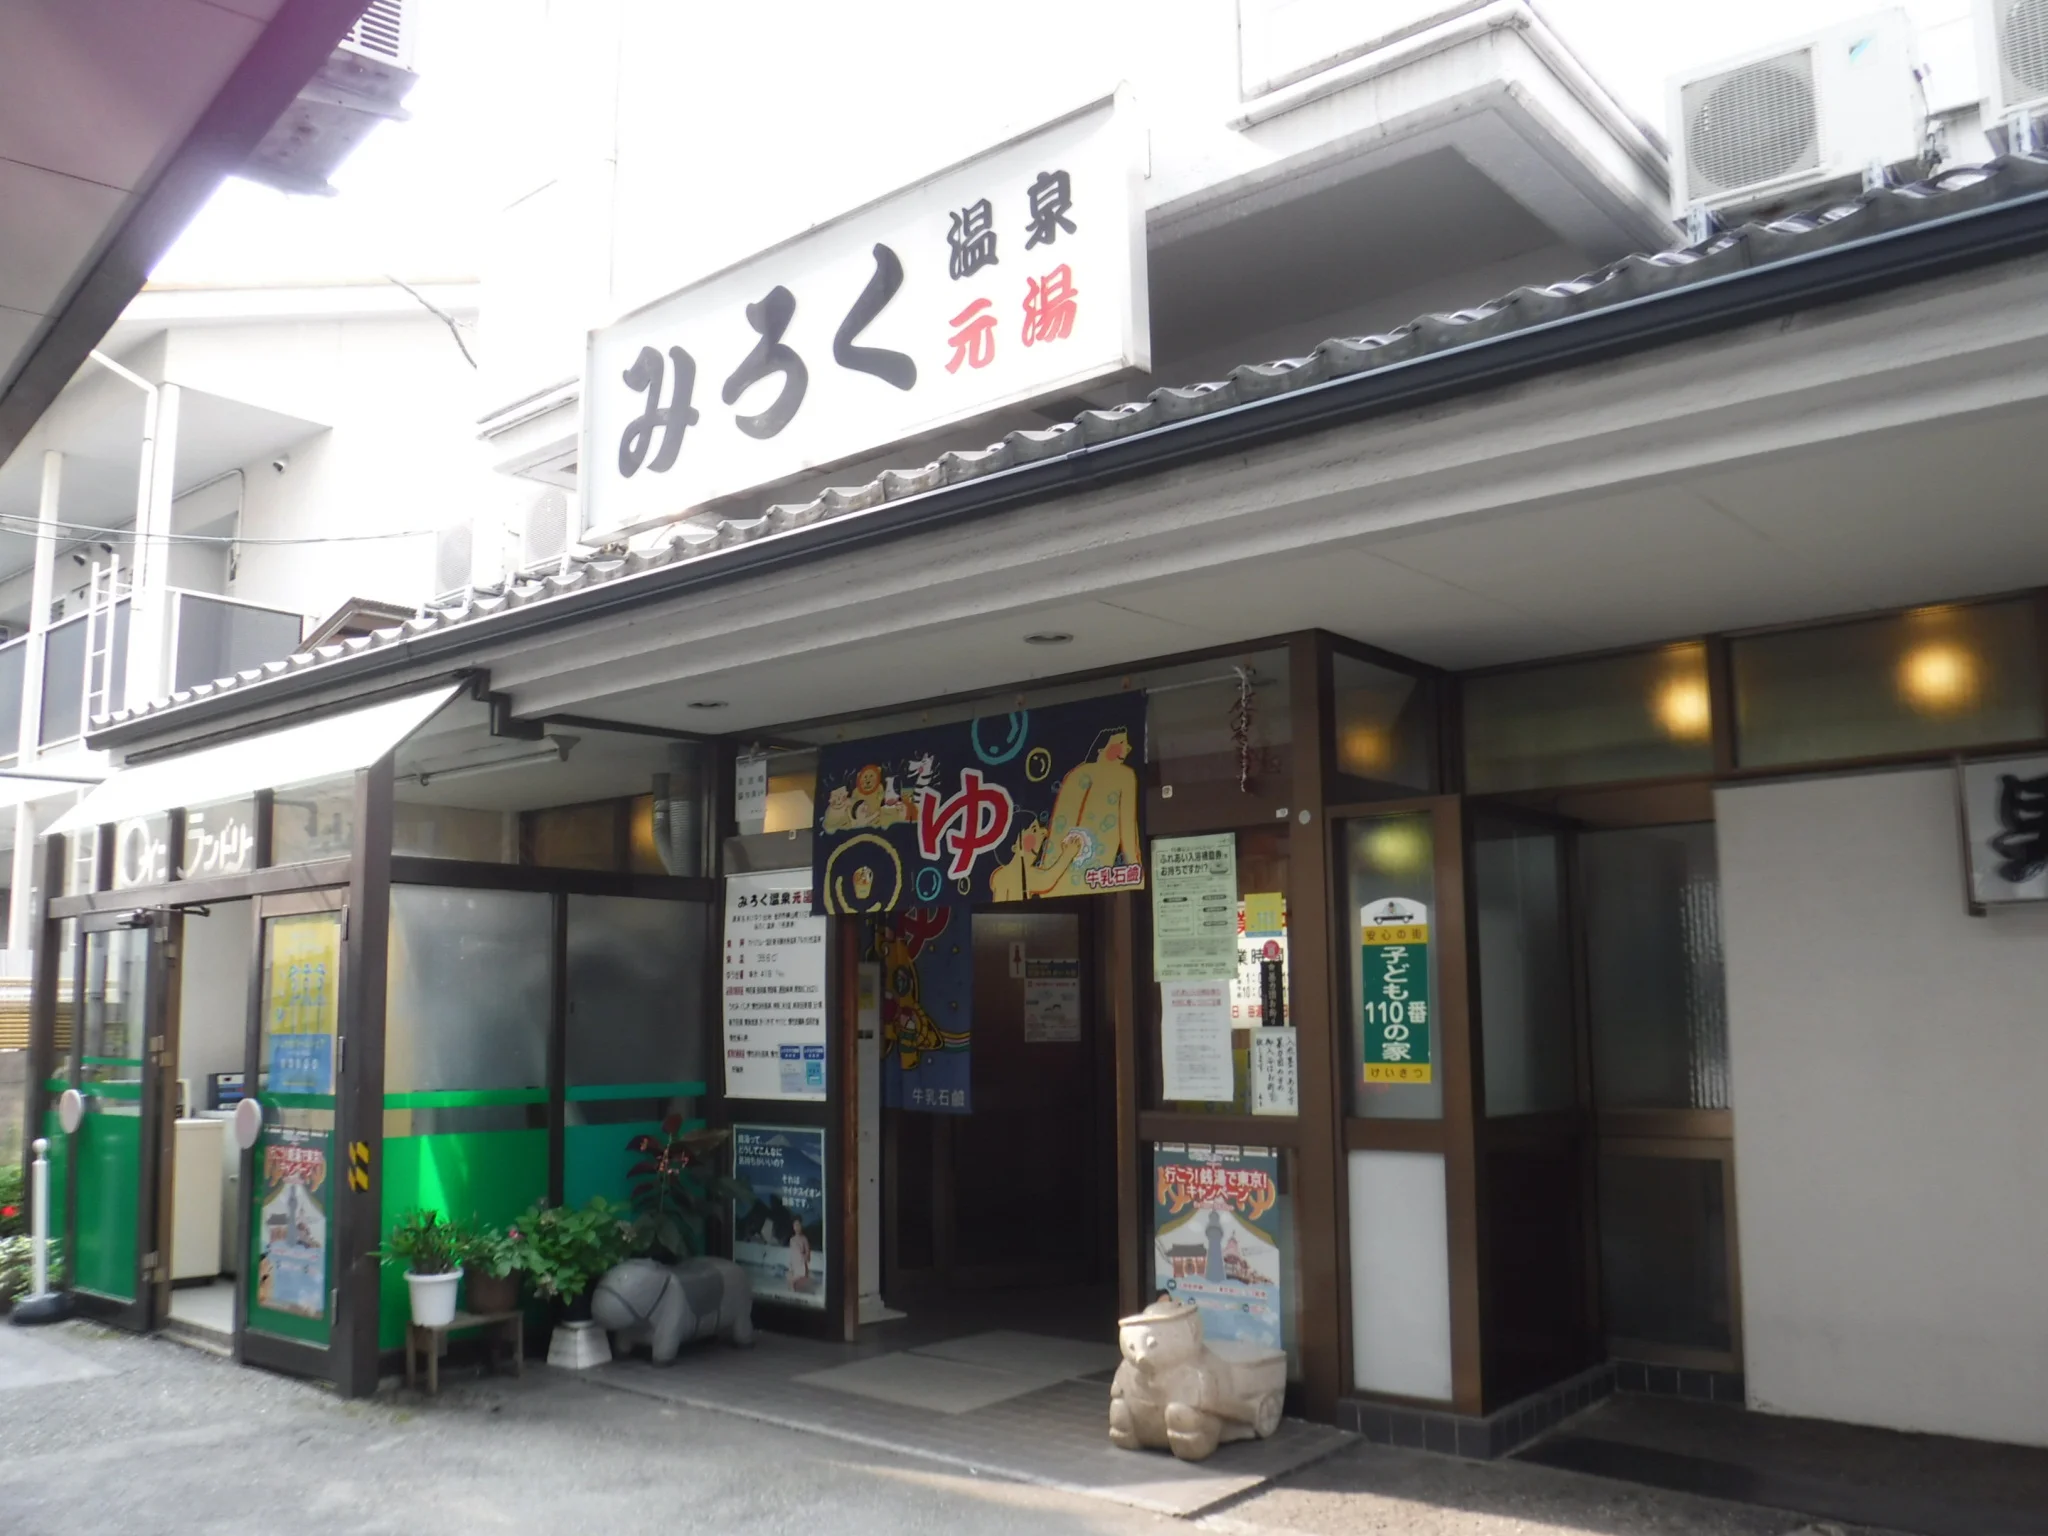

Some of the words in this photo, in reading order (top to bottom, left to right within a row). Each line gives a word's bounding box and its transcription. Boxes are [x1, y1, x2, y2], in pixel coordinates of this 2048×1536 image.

[948, 169, 1078, 281] 温泉
[618, 243, 917, 479] みろく
[944, 263, 1079, 375] 元湯
[917, 766, 1014, 881] ゆ
